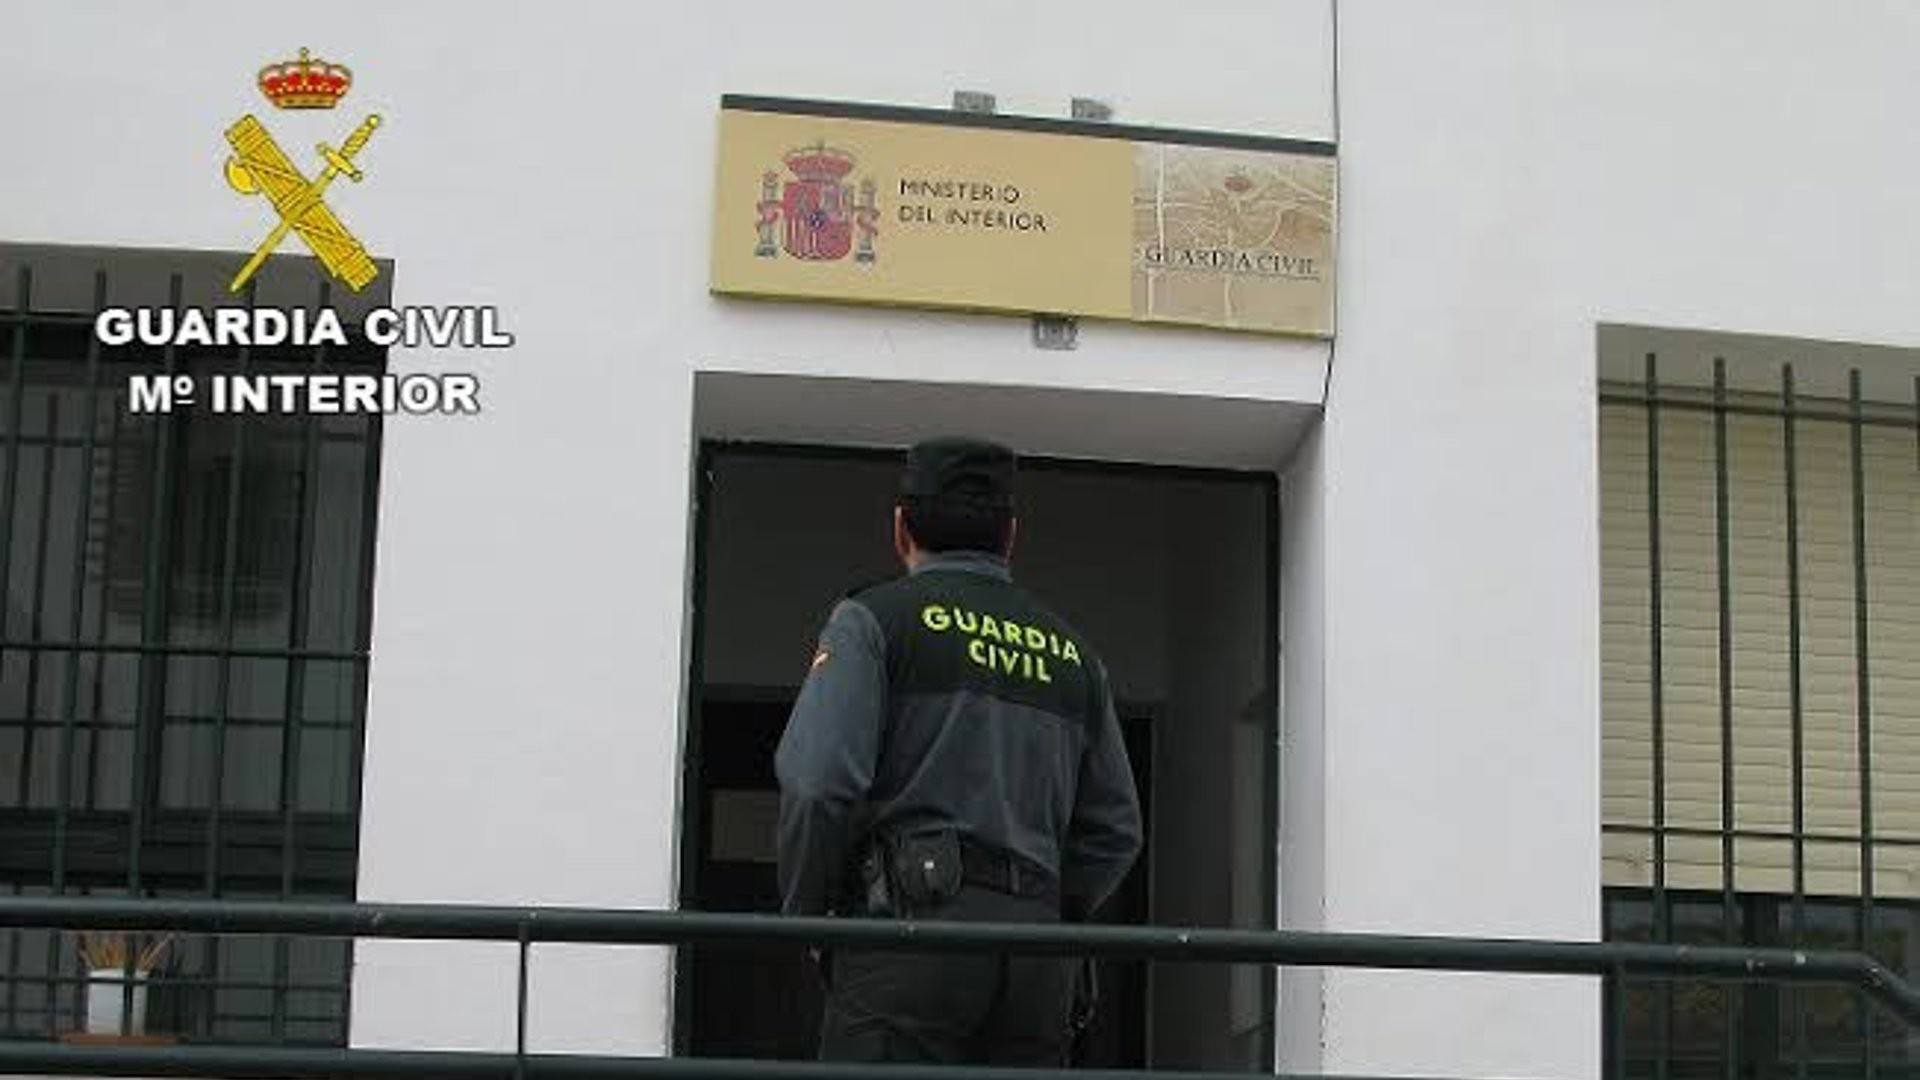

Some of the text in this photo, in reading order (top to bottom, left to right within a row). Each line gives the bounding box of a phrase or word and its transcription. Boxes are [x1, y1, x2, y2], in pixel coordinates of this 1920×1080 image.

[900, 178, 1020, 204] MINISTERIO
[899, 205, 1047, 232] DEL INTERIOR
[1144, 247, 1320, 275] GUARDIA CIVIL
[921, 605, 1082, 667] GUARDIA
[968, 638, 1052, 683] CIVIL
